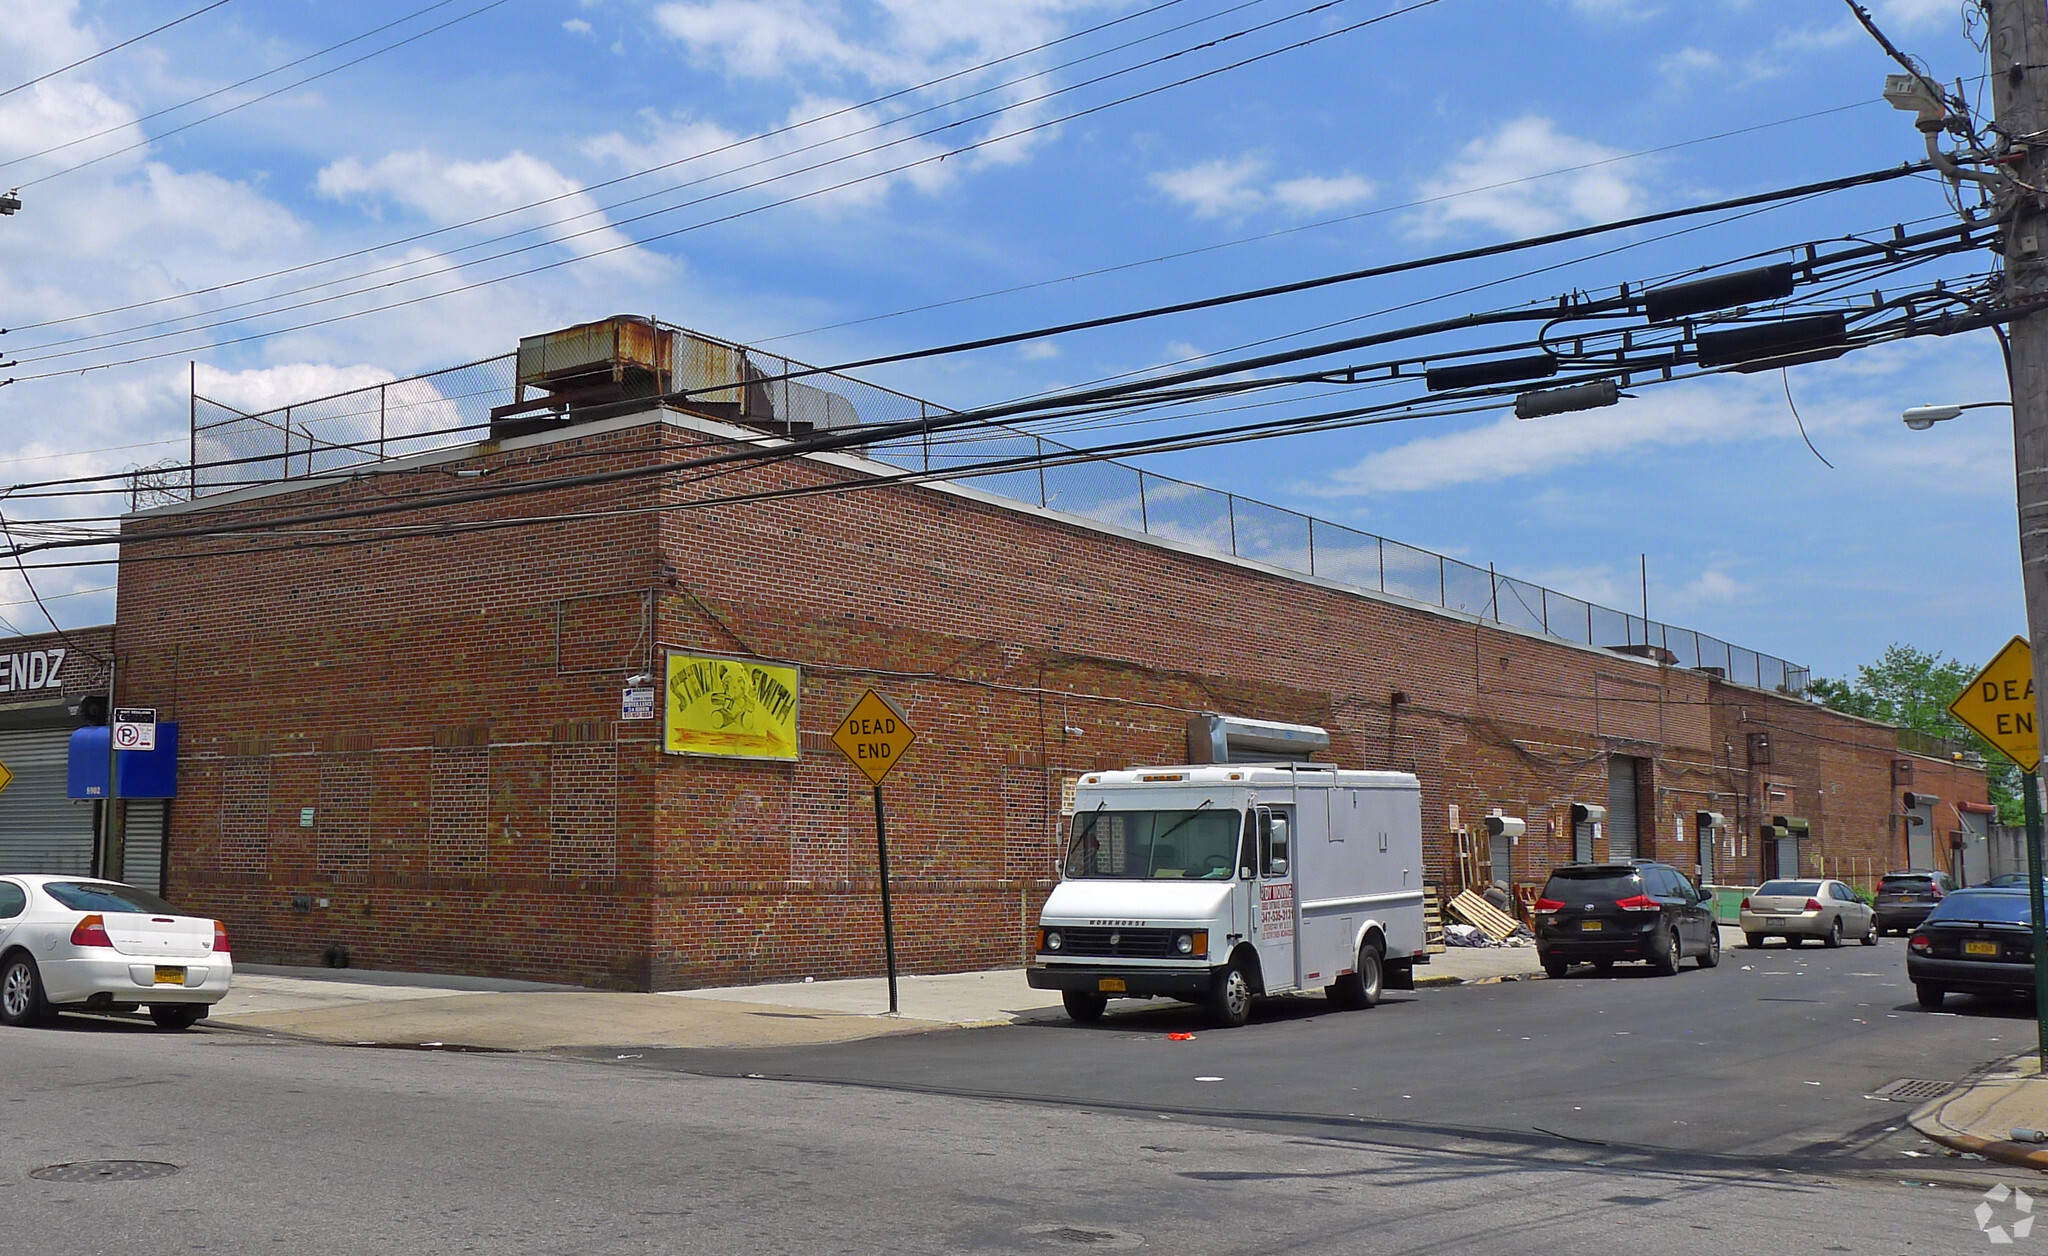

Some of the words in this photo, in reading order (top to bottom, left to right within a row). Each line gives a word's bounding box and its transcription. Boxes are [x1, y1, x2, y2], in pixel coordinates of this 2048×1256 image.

[0, 649, 65, 692] ENDZ
[1982, 679, 2034, 702] DEA
[850, 719, 896, 735] DEAD
[1996, 713, 2034, 735] EN
[858, 743, 891, 759] END
